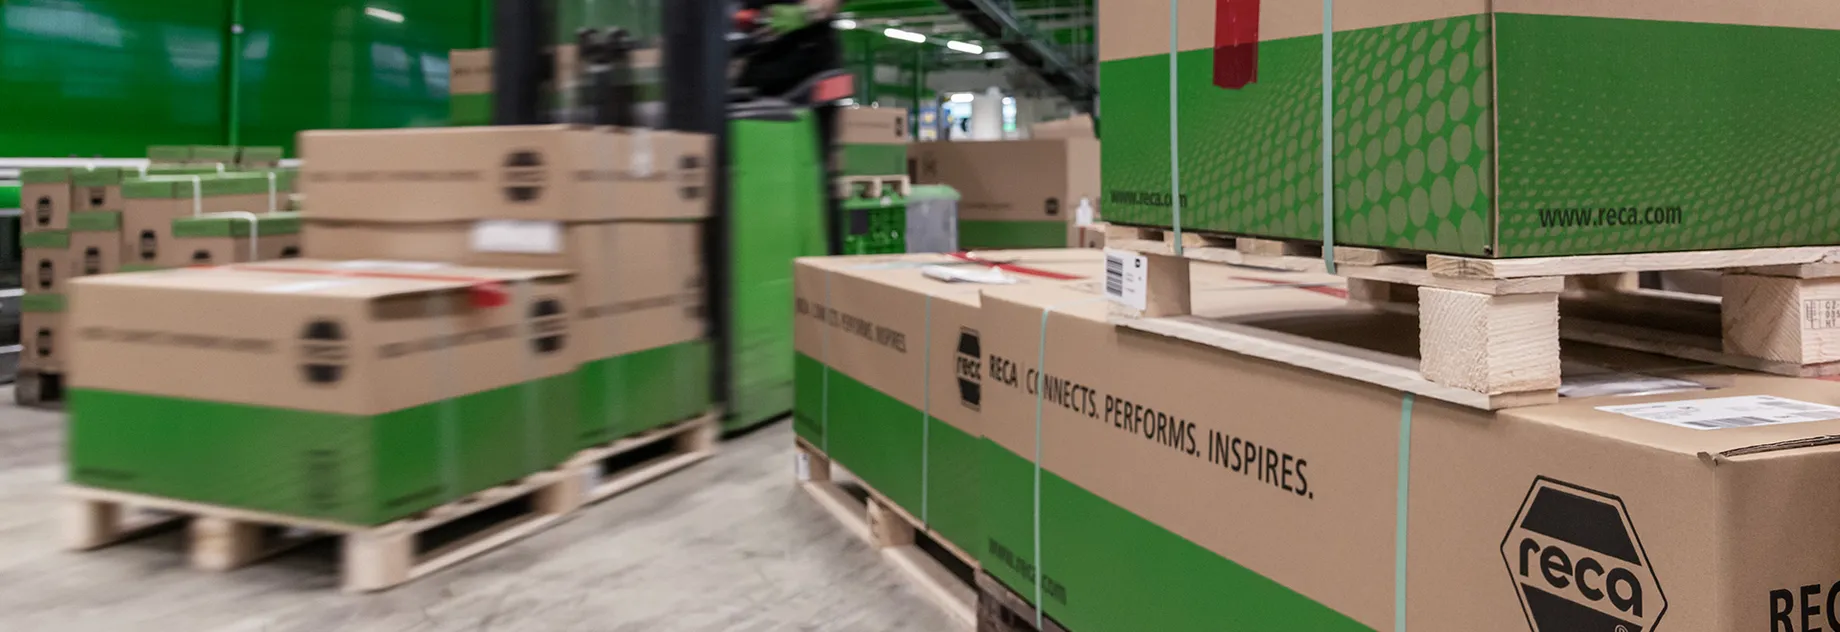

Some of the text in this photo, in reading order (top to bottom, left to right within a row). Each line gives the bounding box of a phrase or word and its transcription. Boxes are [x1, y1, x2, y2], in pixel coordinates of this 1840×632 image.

[1111, 191, 1188, 208] www.reca.cm
[1539, 206, 1683, 228] www.reca.com
[989, 354, 1019, 389] RECA
[1105, 395, 1201, 458] PERFORMS.
[1208, 429, 1315, 500] INSPIRES.
[1518, 537, 1644, 619] reca
